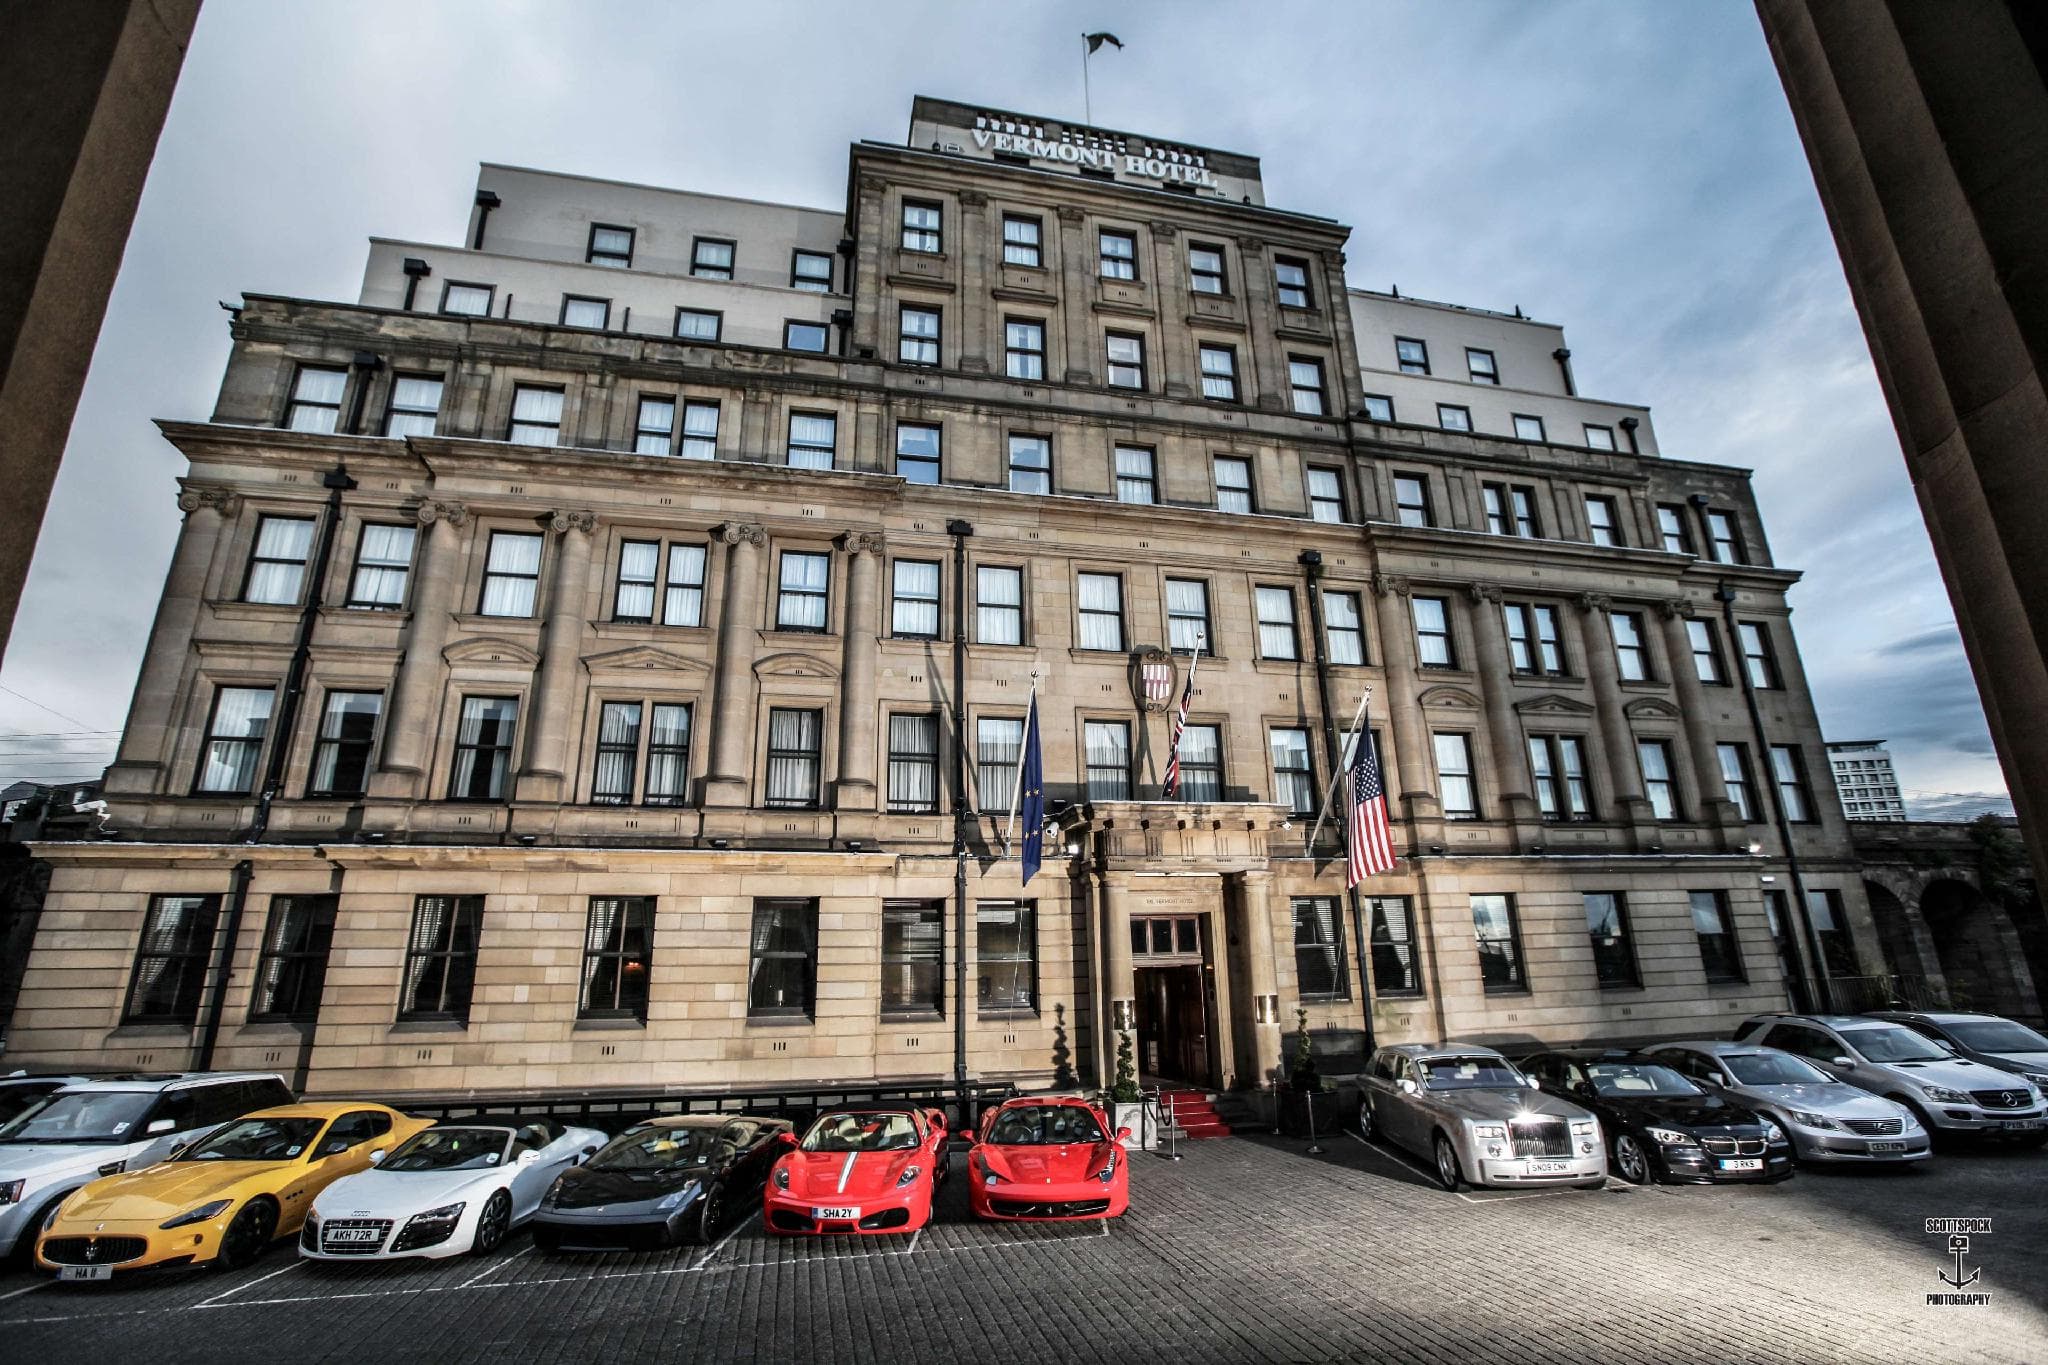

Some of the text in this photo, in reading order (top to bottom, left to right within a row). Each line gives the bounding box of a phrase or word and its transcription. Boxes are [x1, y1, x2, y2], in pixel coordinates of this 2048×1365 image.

[971, 128, 1218, 188] VERMONT HOTEL
[823, 1208, 852, 1218] SHA 2Y
[333, 1230, 373, 1240] AKH 72R
[75, 1267, 88, 1279] HA
